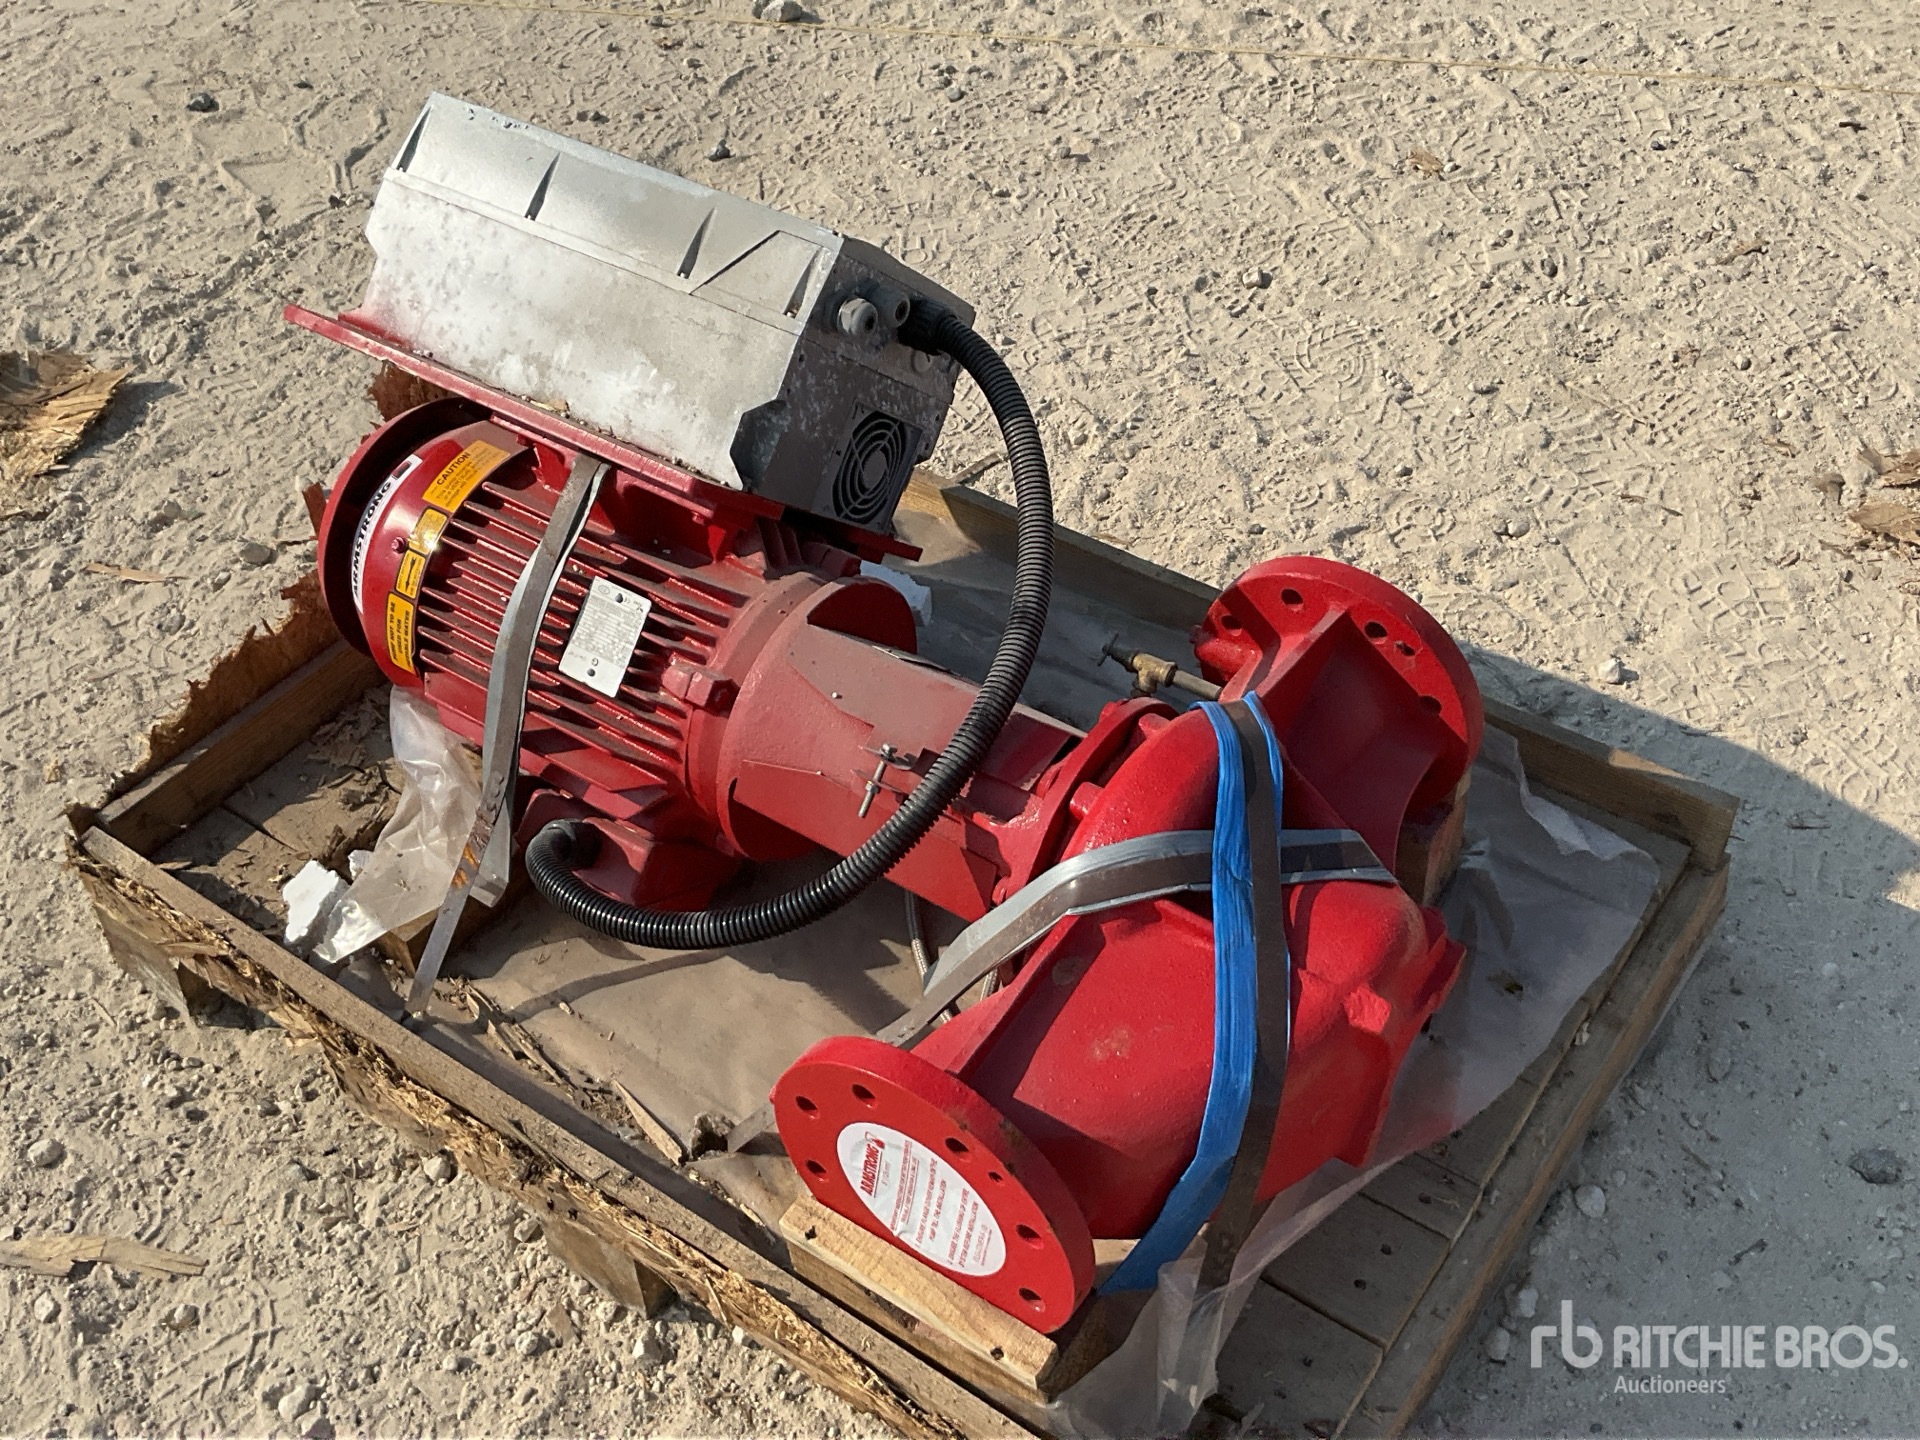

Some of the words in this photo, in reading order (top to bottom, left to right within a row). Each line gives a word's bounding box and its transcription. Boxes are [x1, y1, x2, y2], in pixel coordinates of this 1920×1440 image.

[436, 452, 471, 485] CAUTION
[352, 482, 391, 599] ARMSTRONG
[860, 1143, 878, 1195] ARMSTRONG
